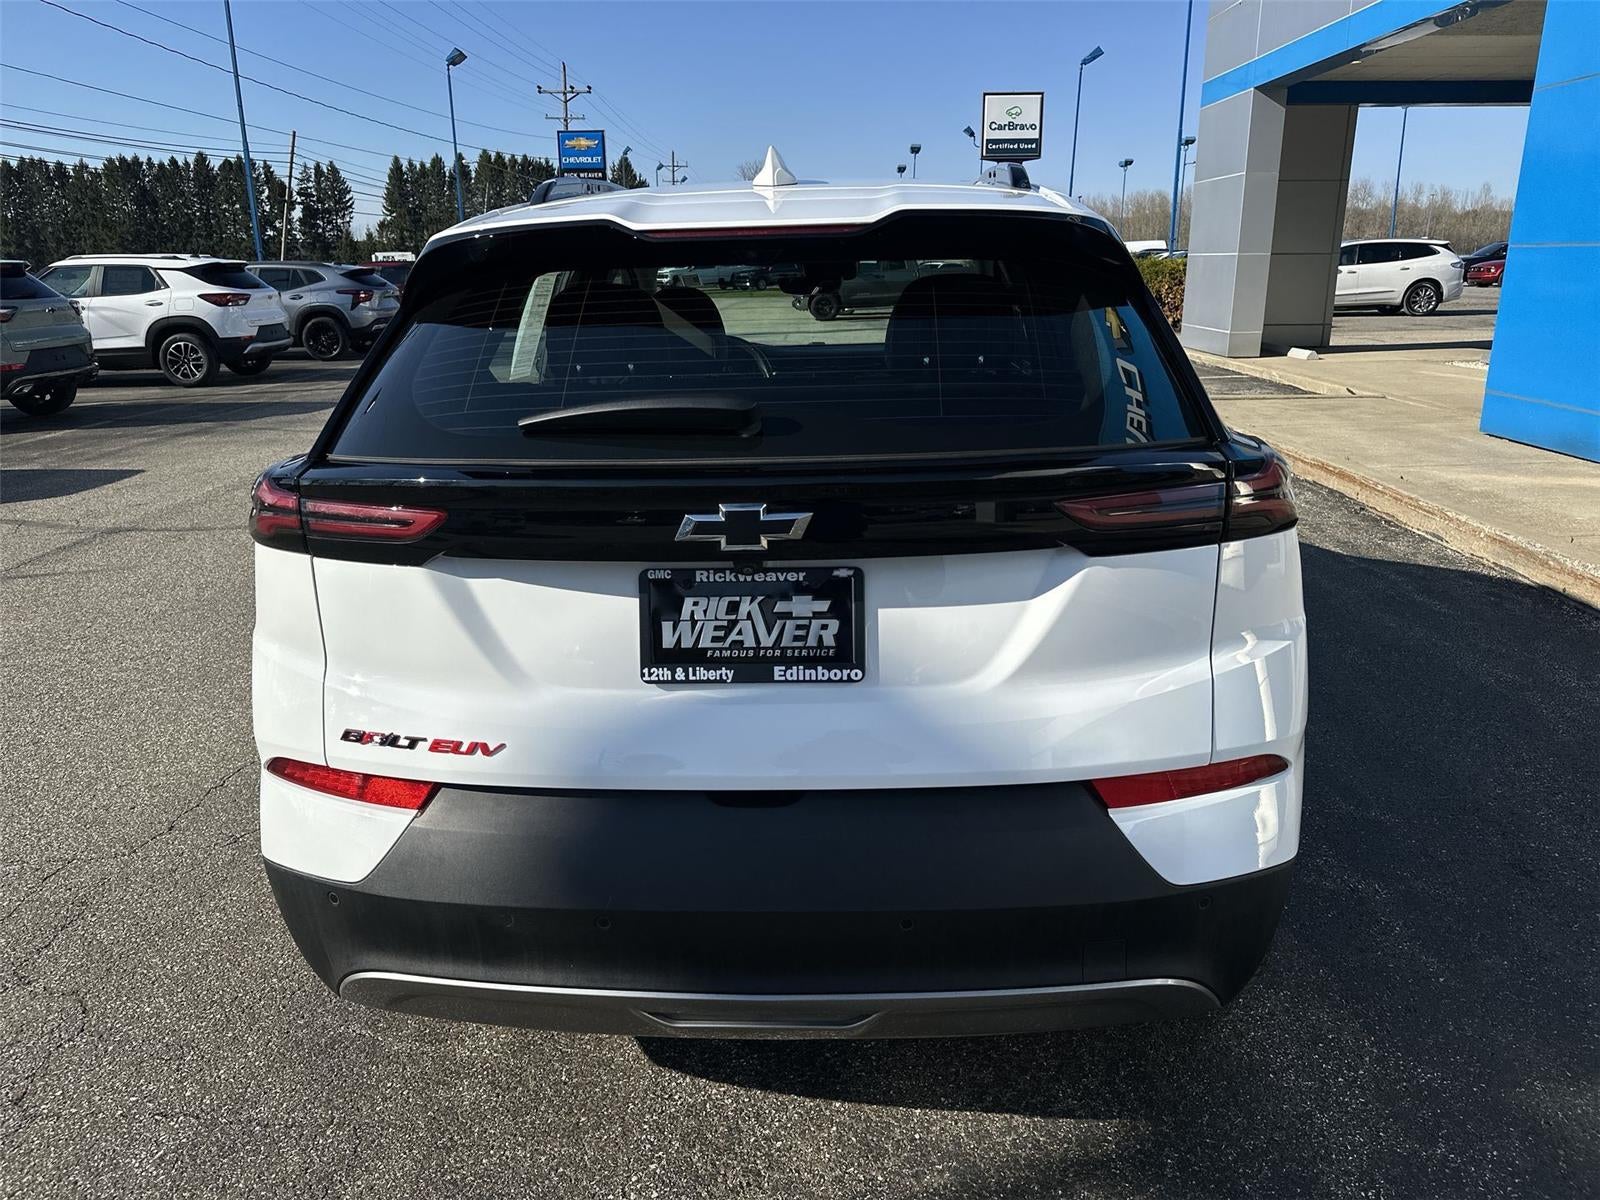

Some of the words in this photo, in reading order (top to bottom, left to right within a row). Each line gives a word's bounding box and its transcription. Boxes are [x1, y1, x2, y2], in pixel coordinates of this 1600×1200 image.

[989, 121, 1037, 131] CarBravo
[562, 156, 602, 164] CHEVROLET
[647, 570, 672, 579] GMC
[680, 596, 767, 624] RICK
[661, 619, 840, 649] WEAVER
[759, 649, 781, 657] FOR
[787, 649, 836, 657] SERVICE
[642, 667, 672, 681] 12th
[675, 667, 686, 681] &
[688, 666, 735, 683] Liberty
[773, 666, 864, 681] Edinboro
[340, 728, 428, 750] BOLT
[428, 739, 507, 757] EUV
